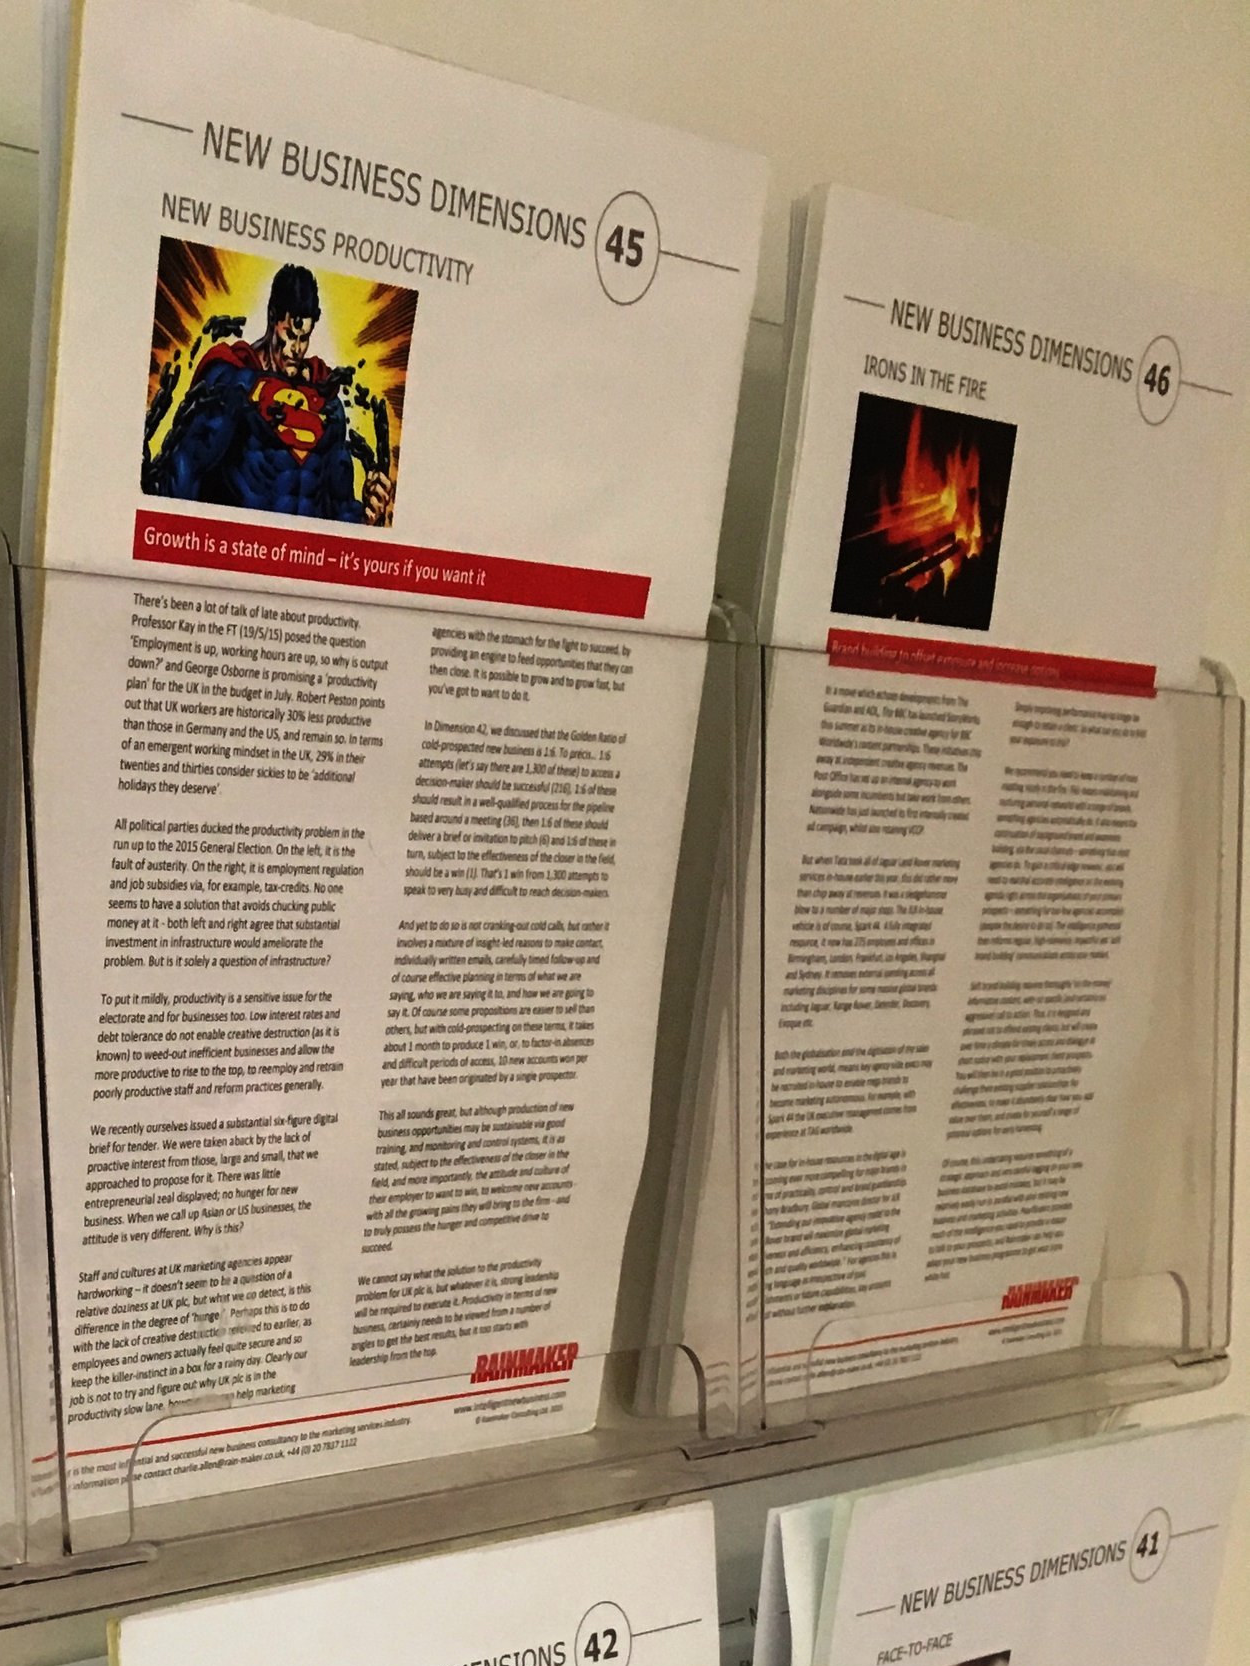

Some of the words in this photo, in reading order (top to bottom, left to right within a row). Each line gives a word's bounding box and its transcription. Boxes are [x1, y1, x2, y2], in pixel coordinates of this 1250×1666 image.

[203, 120, 272, 170] NEW
[281, 141, 422, 206] BUSINESS
[430, 179, 587, 250] DIMENSIONS
[604, 224, 646, 268] 45
[161, 192, 212, 228] NEW
[218, 206, 326, 256] BUSINESS
[332, 233, 474, 286] PRODUCTIVITY
[863, 354, 907, 383] IRONS
[911, 362, 926, 386] IN
[930, 367, 955, 394] THE
[958, 375, 987, 400] FIRE
[890, 297, 933, 334] NEW
[937, 310, 1026, 358] BUSINESS
[1030, 334, 1134, 383] DIMENSIONS
[1144, 362, 1171, 396] 46
[144, 526, 199, 550] Growth
[204, 533, 215, 552] is
[219, 540, 227, 553] a
[231, 539, 267, 559] state
[271, 542, 287, 560] of
[288, 546, 325, 565] mind
[339, 551, 359, 570] it's
[363, 558, 399, 576] yours
[402, 559, 413, 576] if
[415, 565, 438, 582] you
[442, 569, 473, 584] want
[476, 568, 485, 585] it
[900, 1586, 939, 1616] NEW
[943, 1566, 1025, 1605] BUSINESS
[1030, 1540, 1126, 1584] DIMENSIONS
[1136, 1530, 1159, 1558] 41
[583, 1628, 619, 1664] 42
[876, 1632, 953, 1666] FACE-TO-FACE
